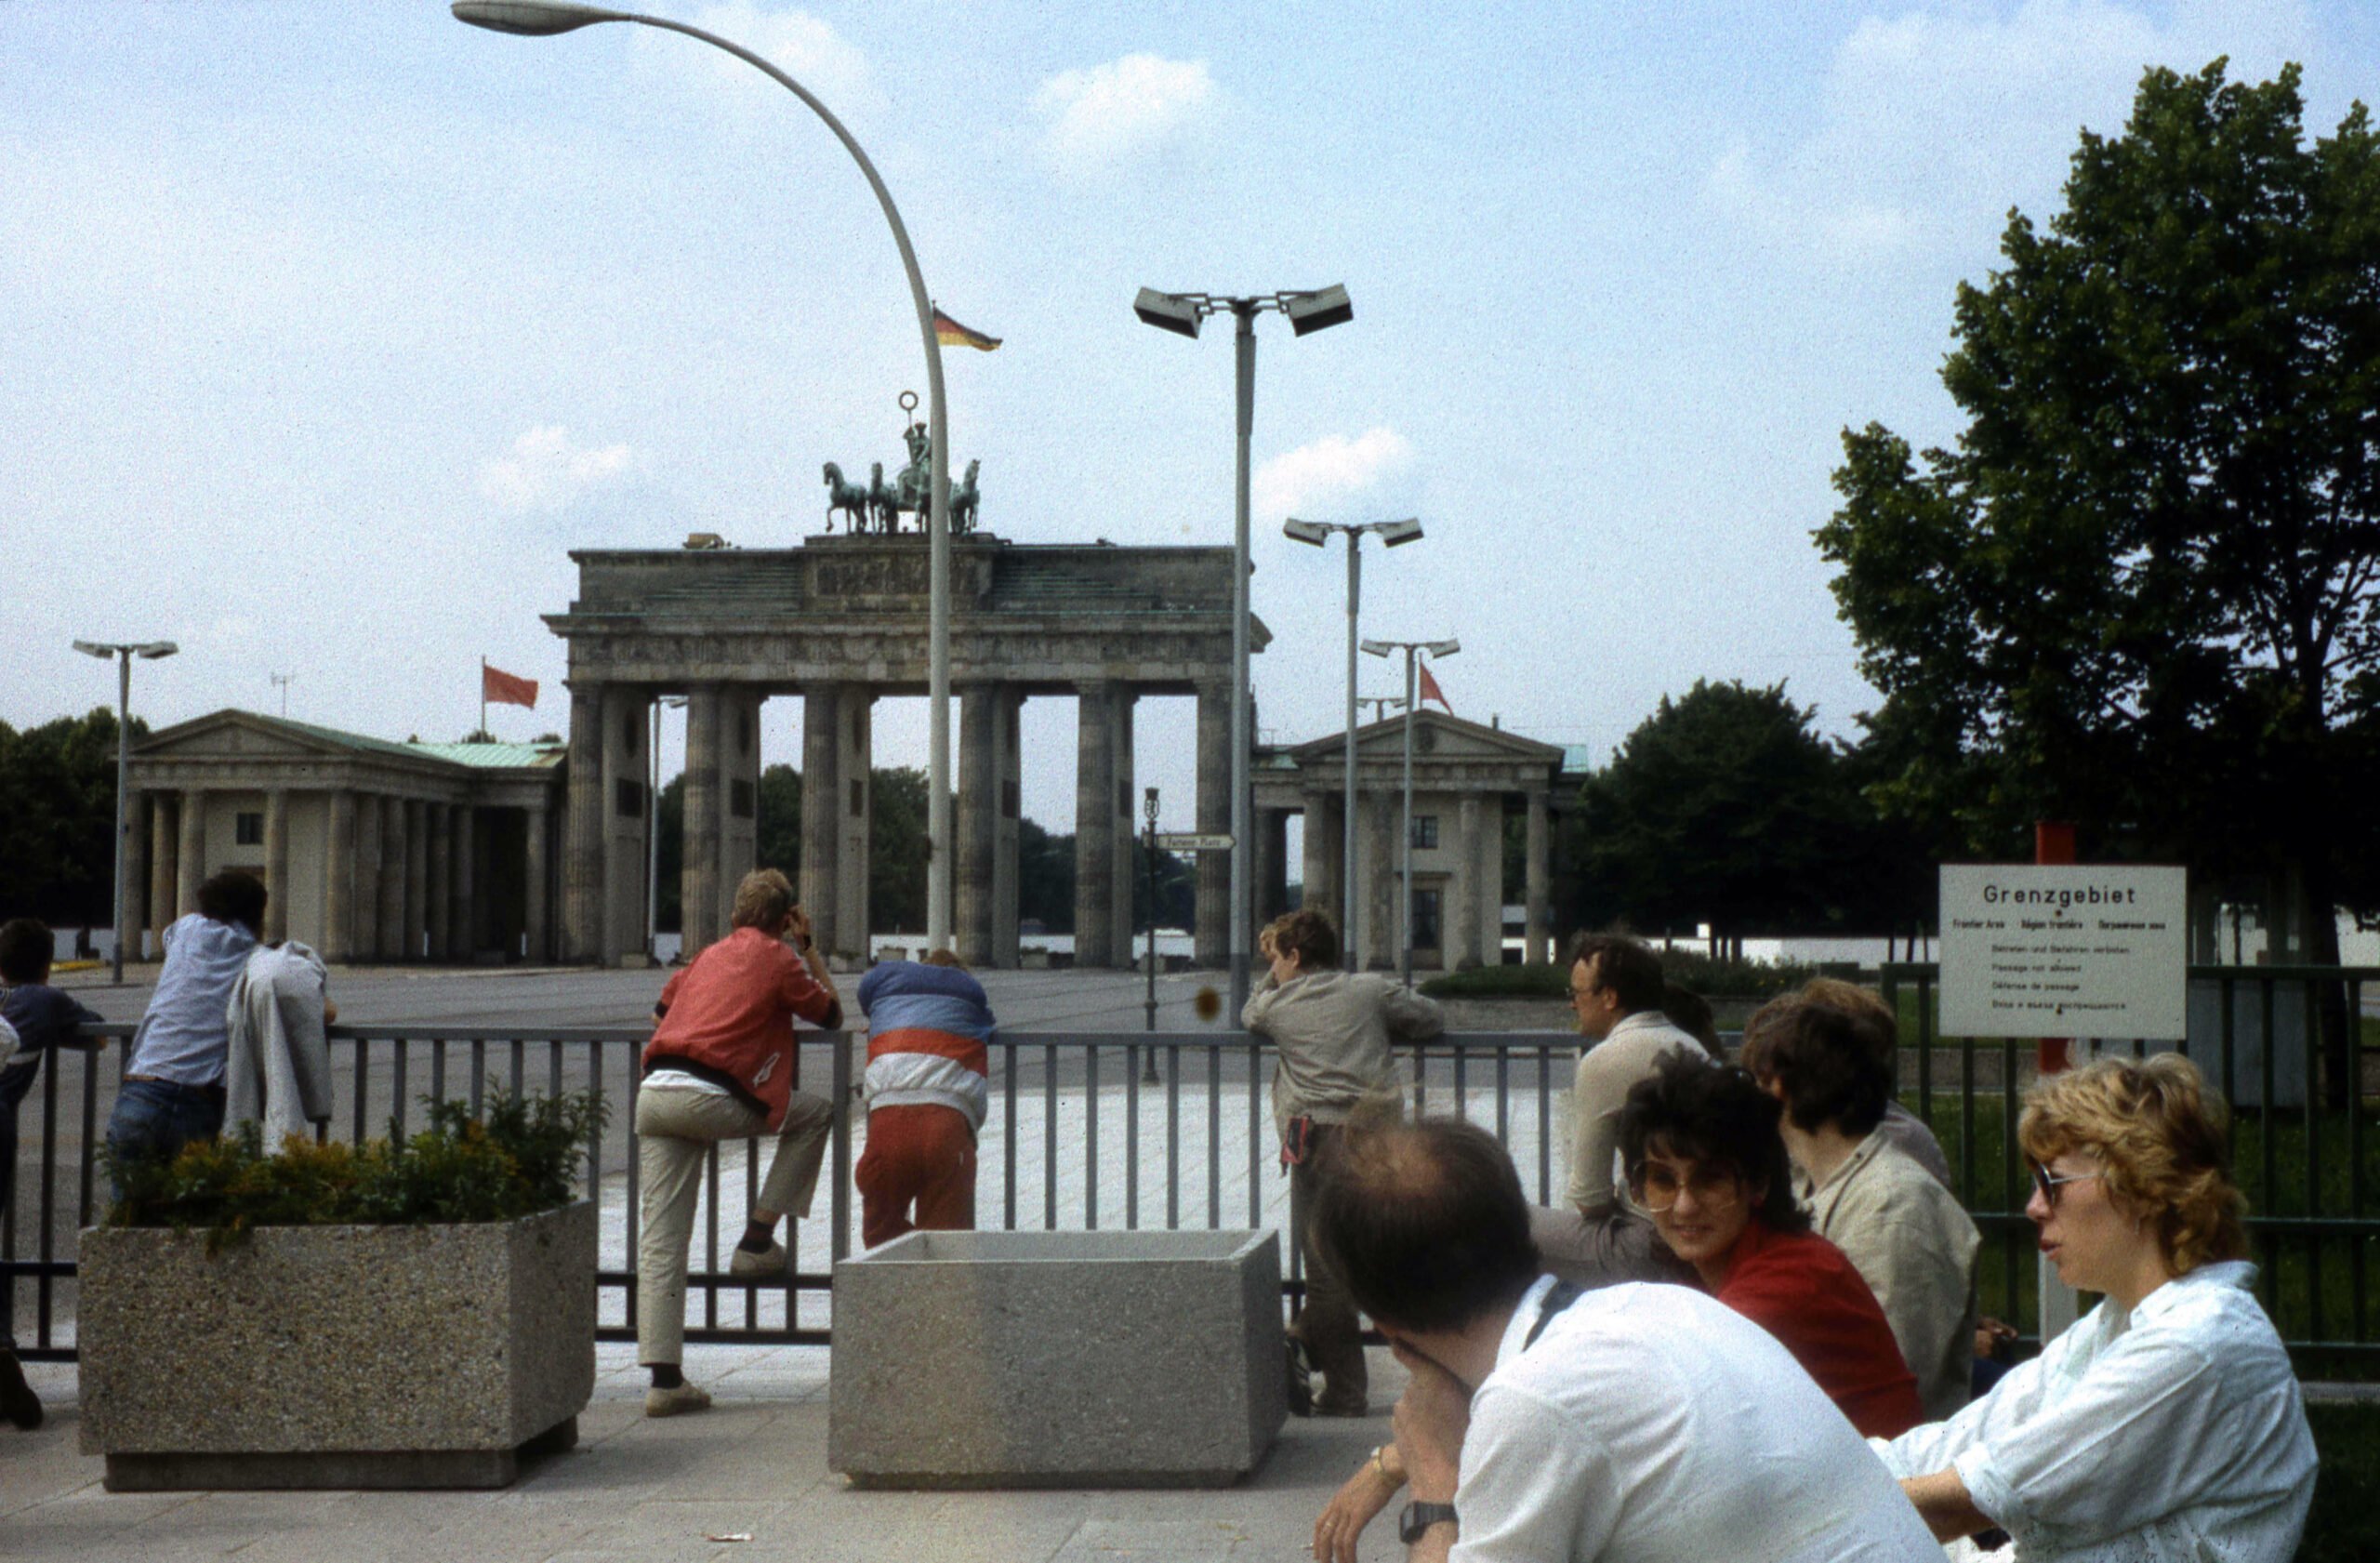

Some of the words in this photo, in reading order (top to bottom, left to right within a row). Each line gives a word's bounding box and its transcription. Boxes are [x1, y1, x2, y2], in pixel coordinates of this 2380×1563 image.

[1983, 884, 2136, 907] Grenzgebiet
[1952, 919, 1984, 930] Frontier
[1986, 919, 2005, 930] Area
[1991, 944, 2028, 954] Betreten
[2031, 945, 2046, 954] und
[2049, 945, 2090, 954] Befahren
[2093, 945, 2131, 955] verboten
[1991, 963, 2028, 974] Passage
[2031, 964, 2045, 973] not
[2049, 963, 2082, 973] allowed
[2030, 982, 2042, 990] de
[2044, 983, 2080, 992] passage
